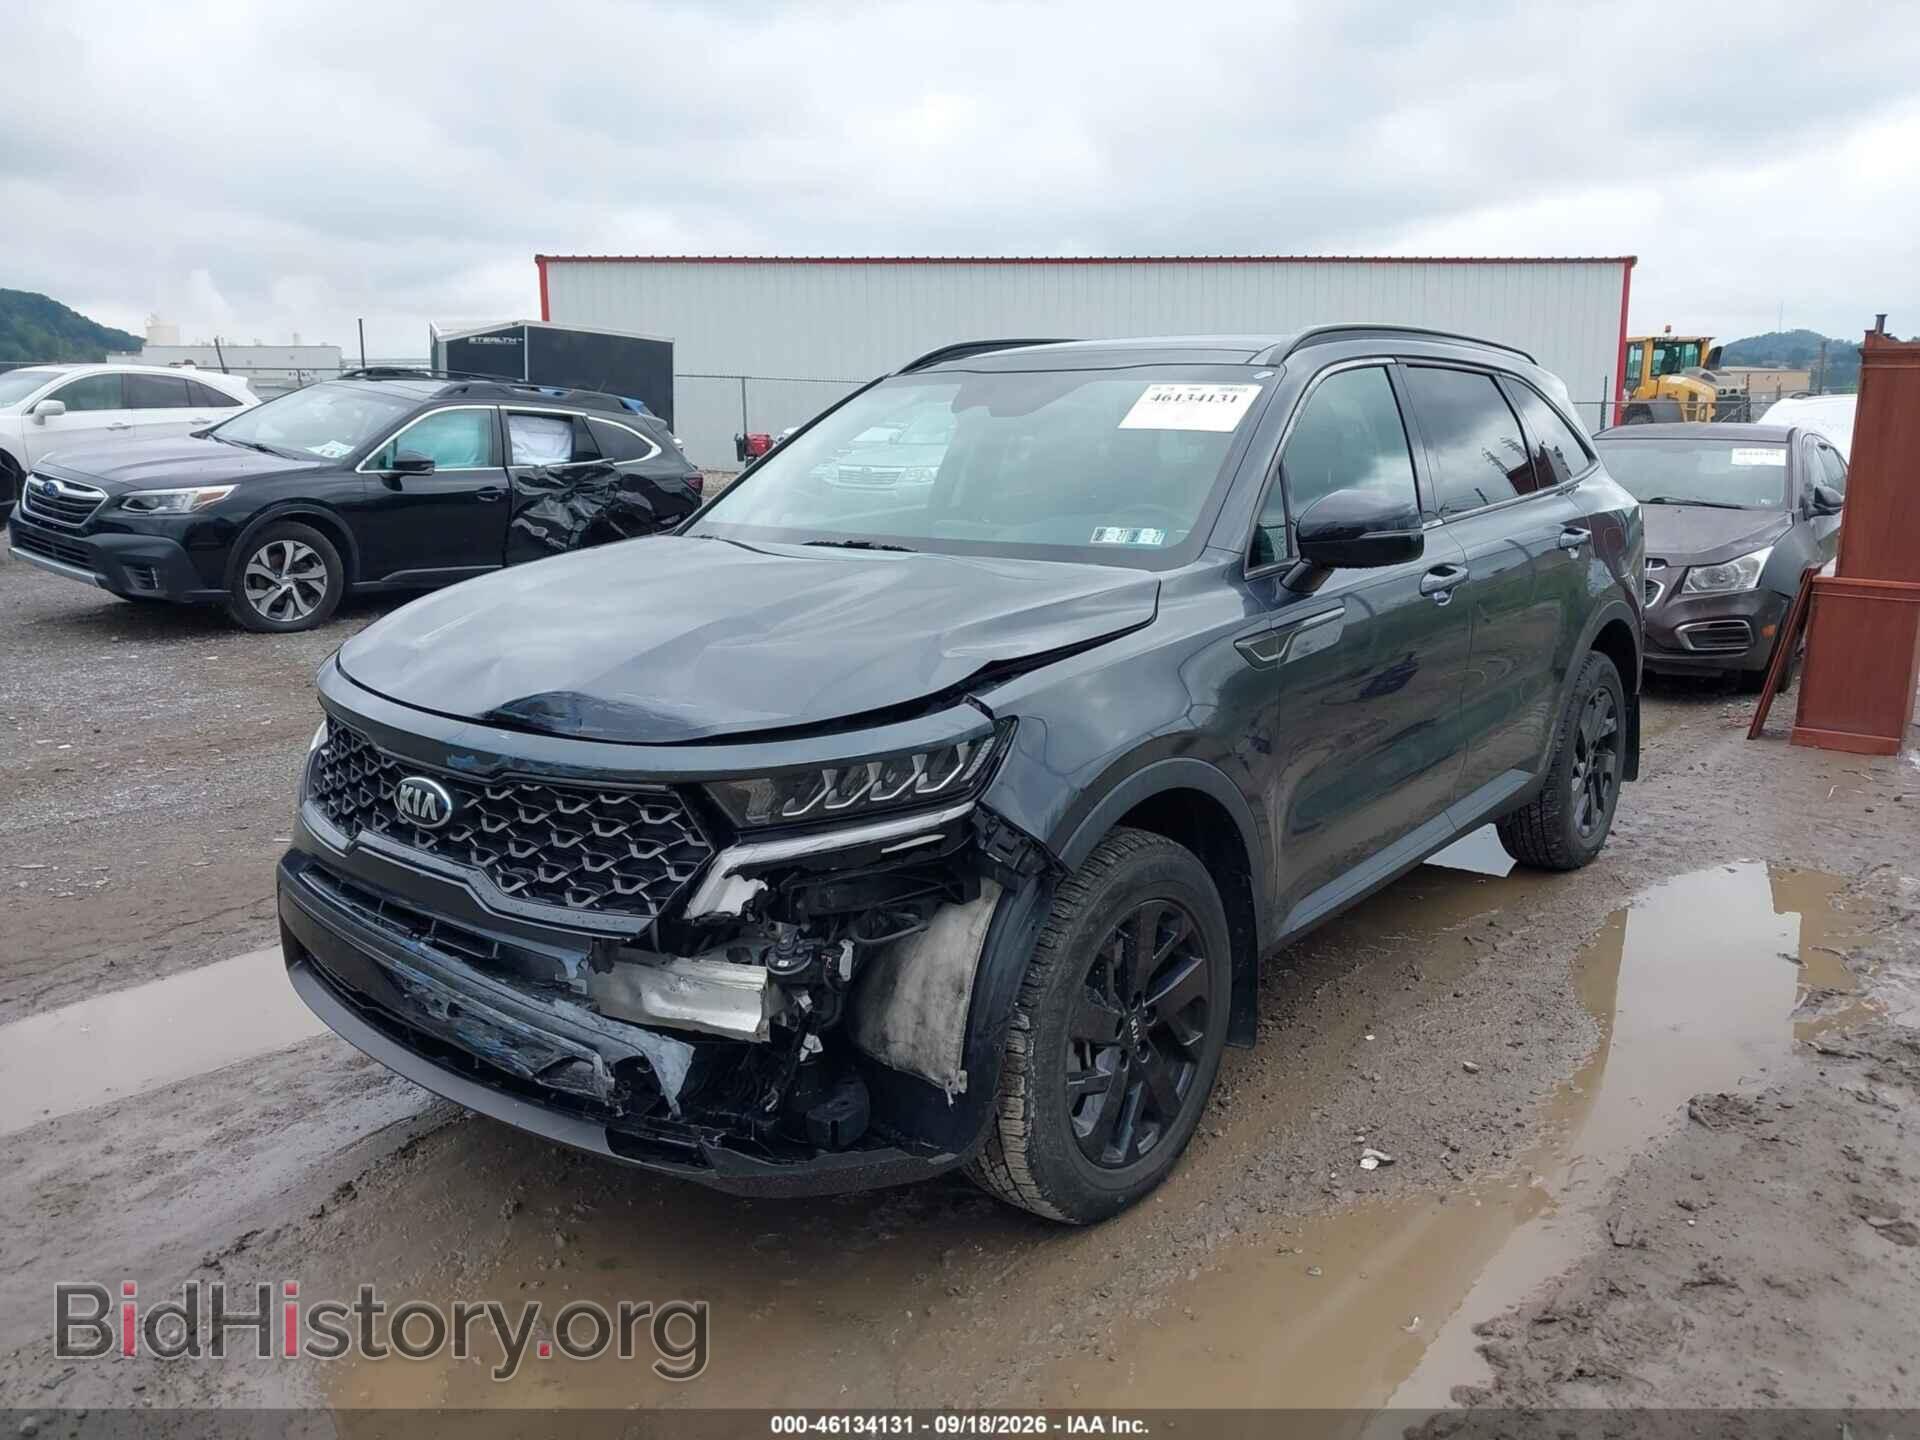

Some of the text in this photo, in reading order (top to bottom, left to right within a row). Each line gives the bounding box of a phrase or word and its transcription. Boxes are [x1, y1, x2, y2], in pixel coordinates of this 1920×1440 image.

[467, 336, 517, 345] STEALTH
[1150, 393, 1239, 404] 46134131
[399, 784, 438, 821] KIA
